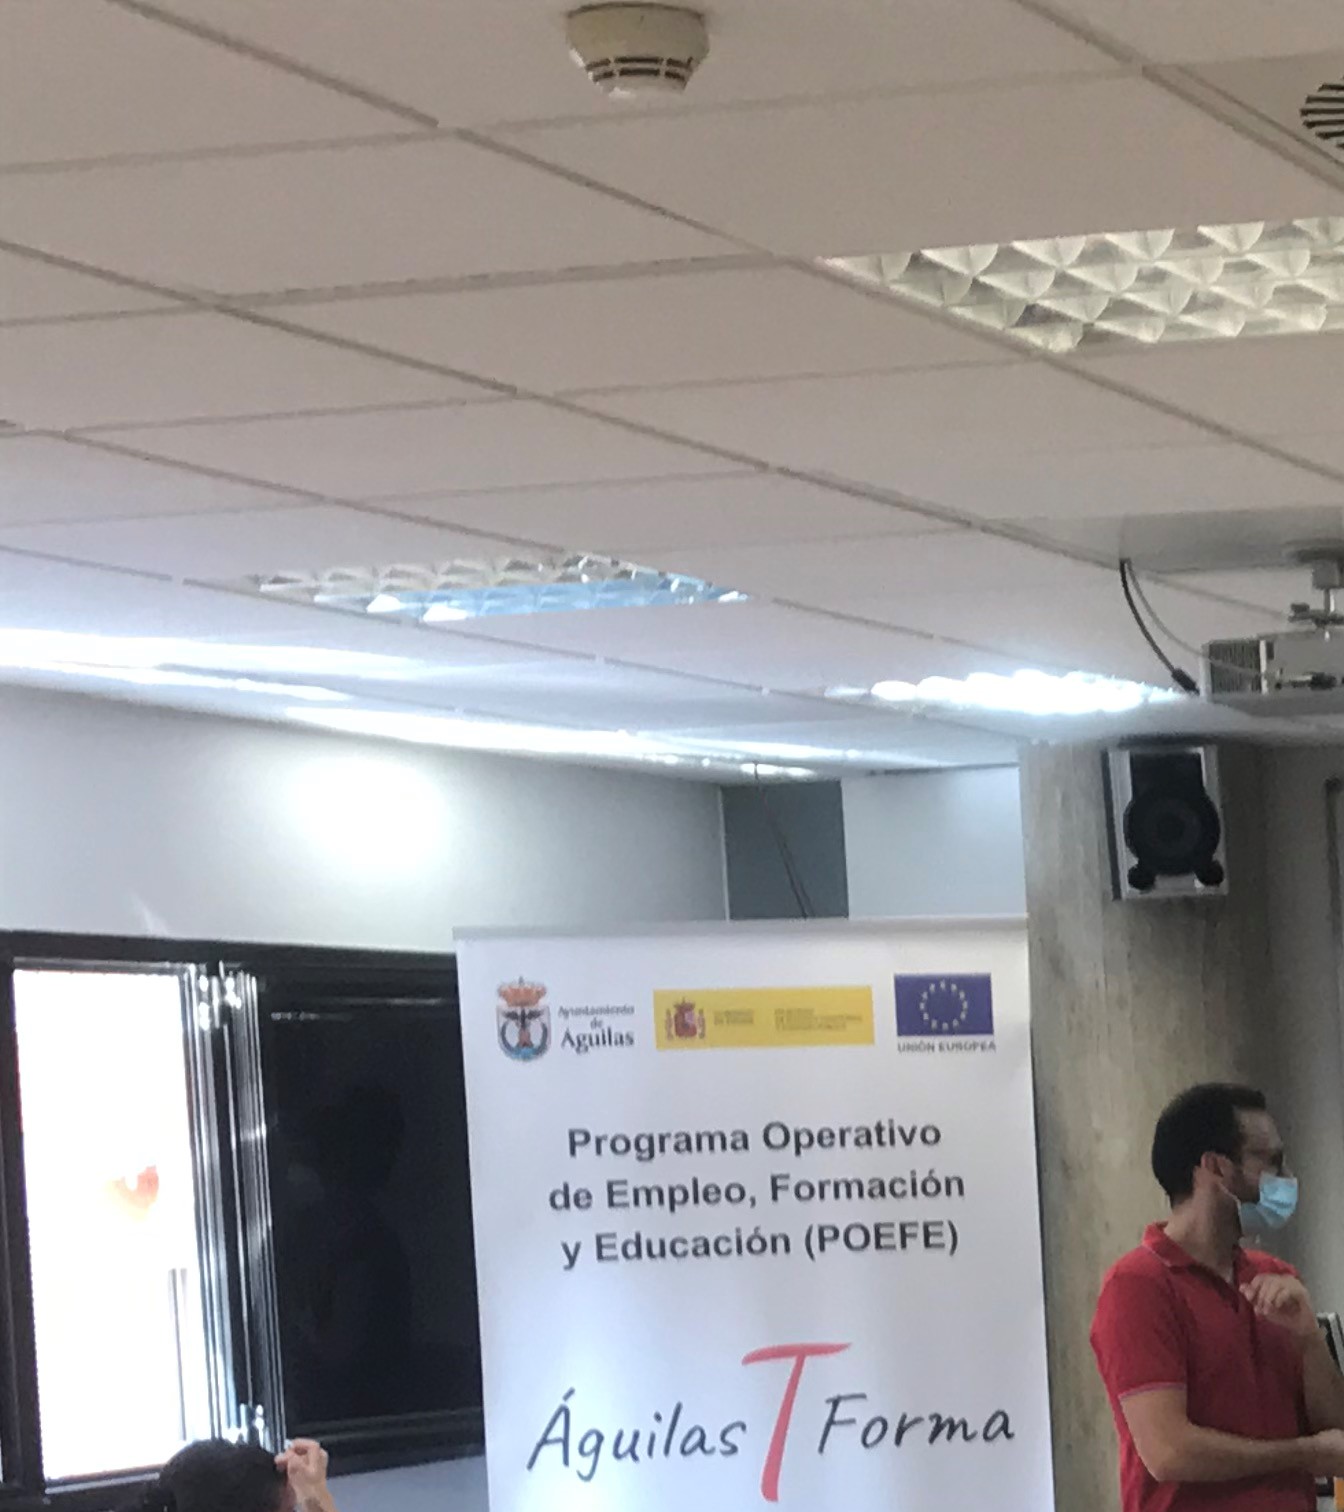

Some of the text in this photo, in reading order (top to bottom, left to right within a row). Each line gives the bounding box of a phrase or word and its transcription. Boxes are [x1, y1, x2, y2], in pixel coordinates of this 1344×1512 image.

[560, 1026, 635, 1054] Águilas
[567, 1119, 942, 1162] Programa Operativo
[549, 1169, 966, 1213] de Empleo, Formación
[561, 1219, 960, 1271] y Educación (POEFE)
[526, 1342, 1015, 1502] Águilas T Forma
